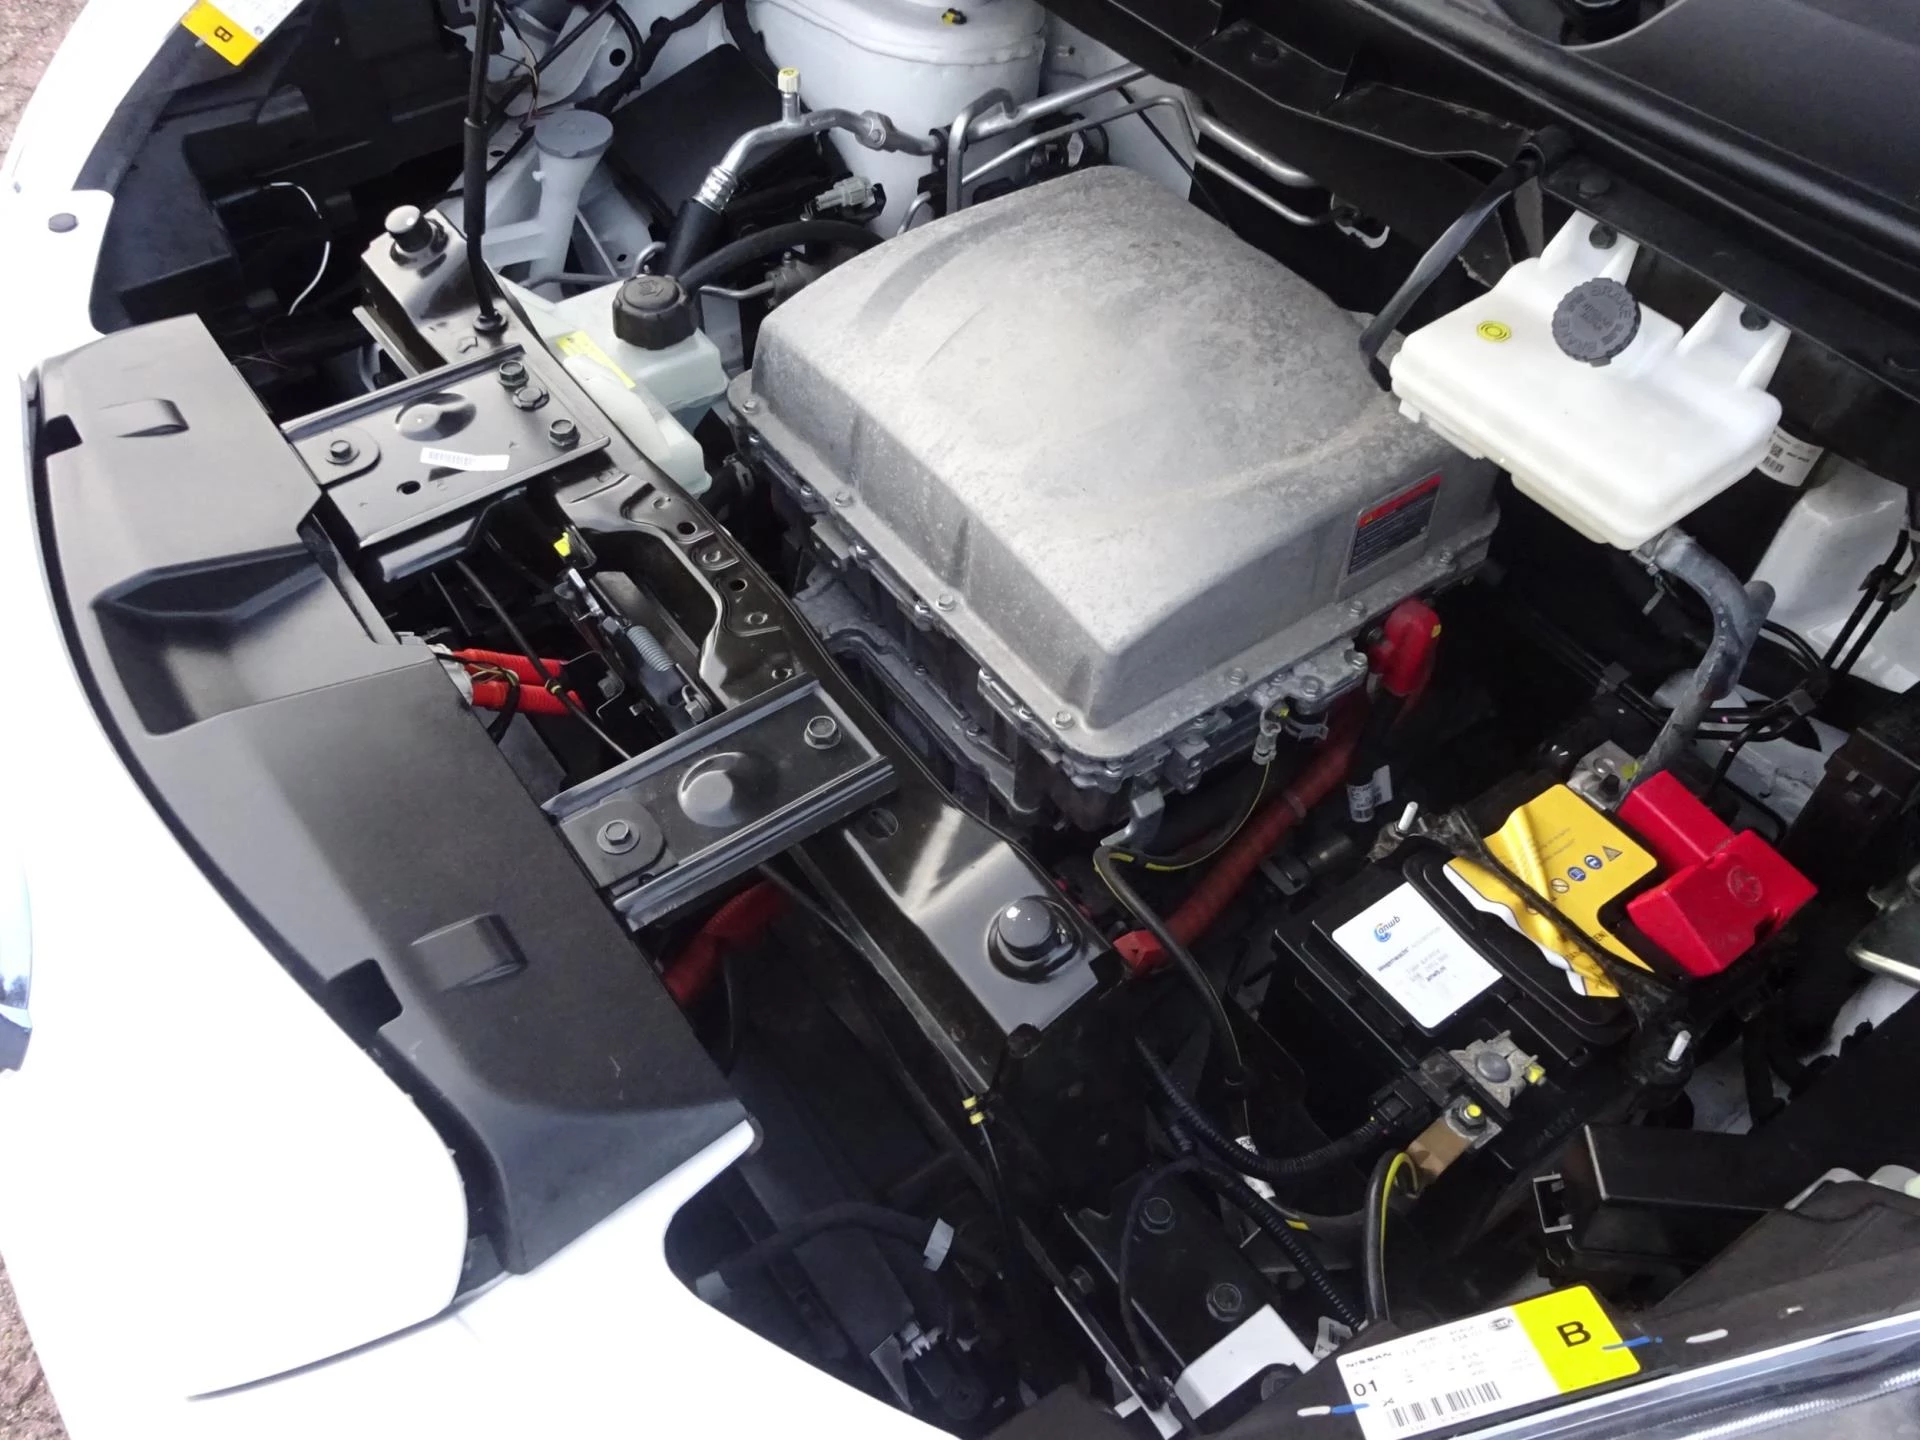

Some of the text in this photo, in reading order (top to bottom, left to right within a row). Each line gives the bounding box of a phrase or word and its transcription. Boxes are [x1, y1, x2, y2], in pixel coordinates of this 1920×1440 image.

[214, 25, 234, 43] B
[1378, 915, 1401, 934] anwb
[1557, 1320, 1592, 1347] B
[1346, 1352, 1392, 1367] NISSAN
[1353, 1379, 1378, 1397] 01
